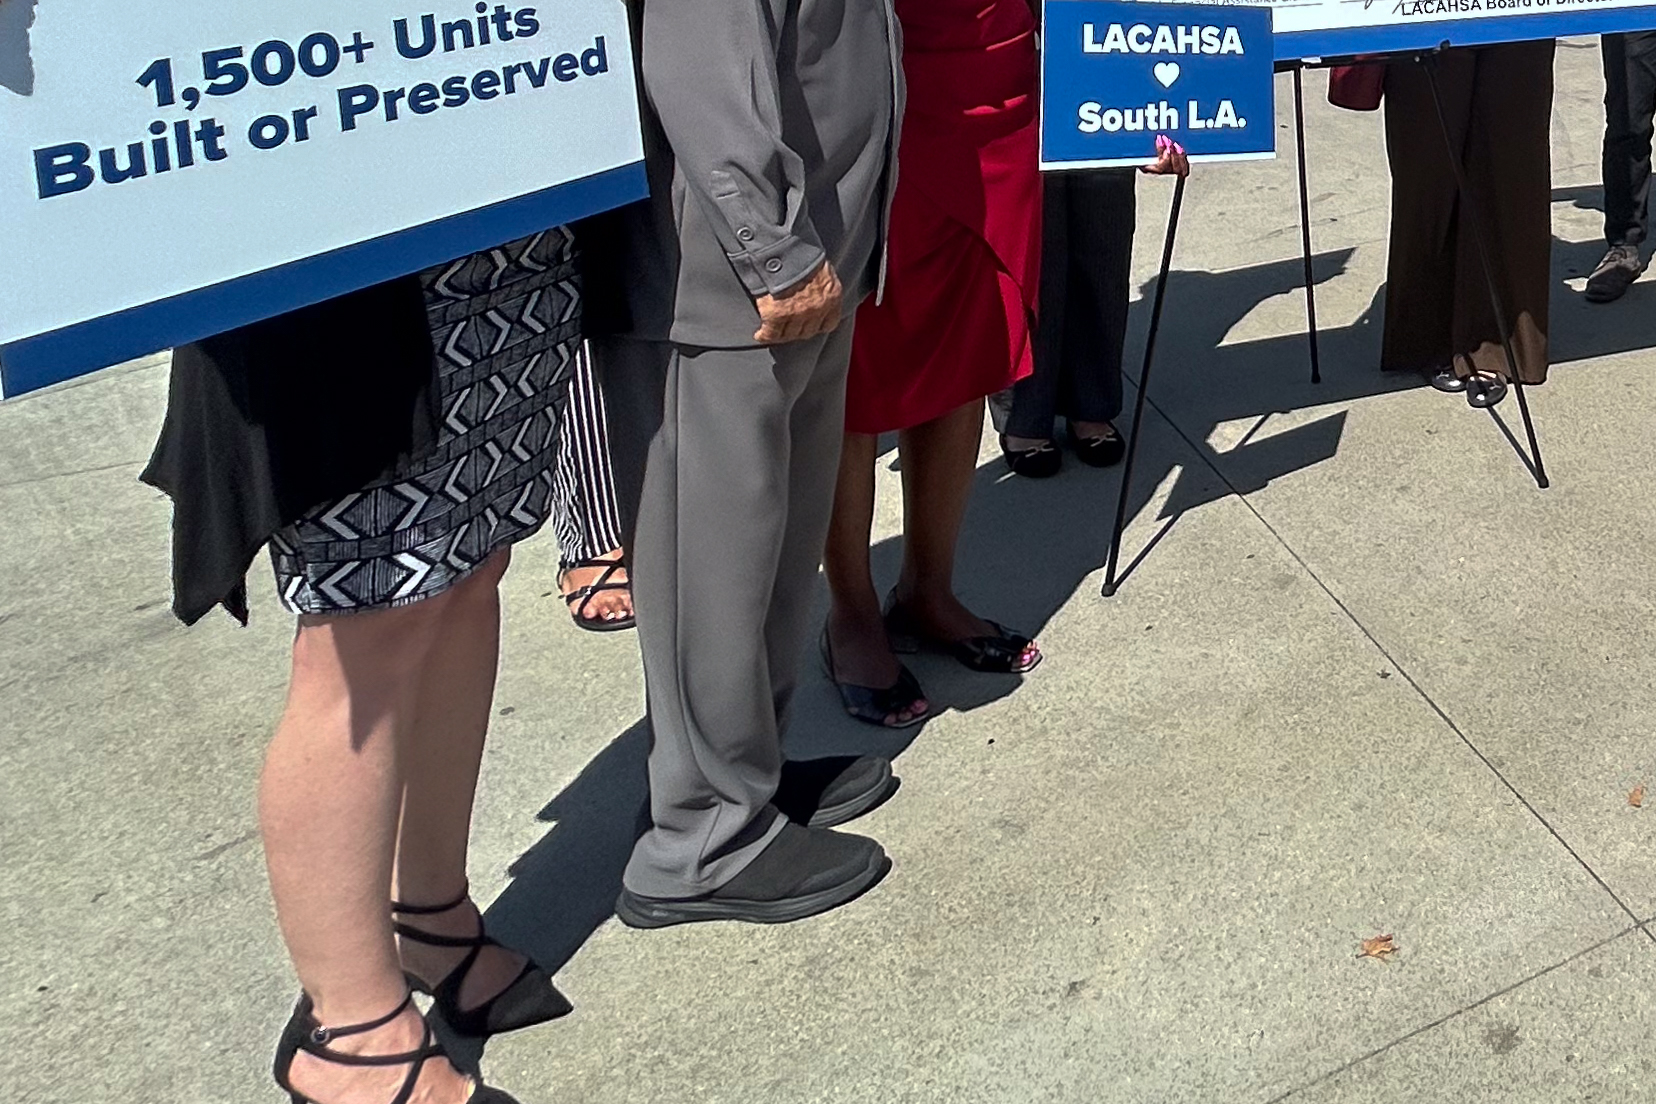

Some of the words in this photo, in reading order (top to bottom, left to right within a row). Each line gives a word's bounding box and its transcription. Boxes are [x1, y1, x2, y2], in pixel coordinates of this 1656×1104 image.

[136, 31, 374, 112] 1,500+
[394, 2, 540, 59] Units
[1083, 23, 1245, 56] LACAHSA
[33, 116, 227, 200] Built
[248, 106, 318, 150] or
[337, 36, 609, 132] Preserved
[1078, 99, 1179, 133] South
[1188, 100, 1247, 130] L.A.
